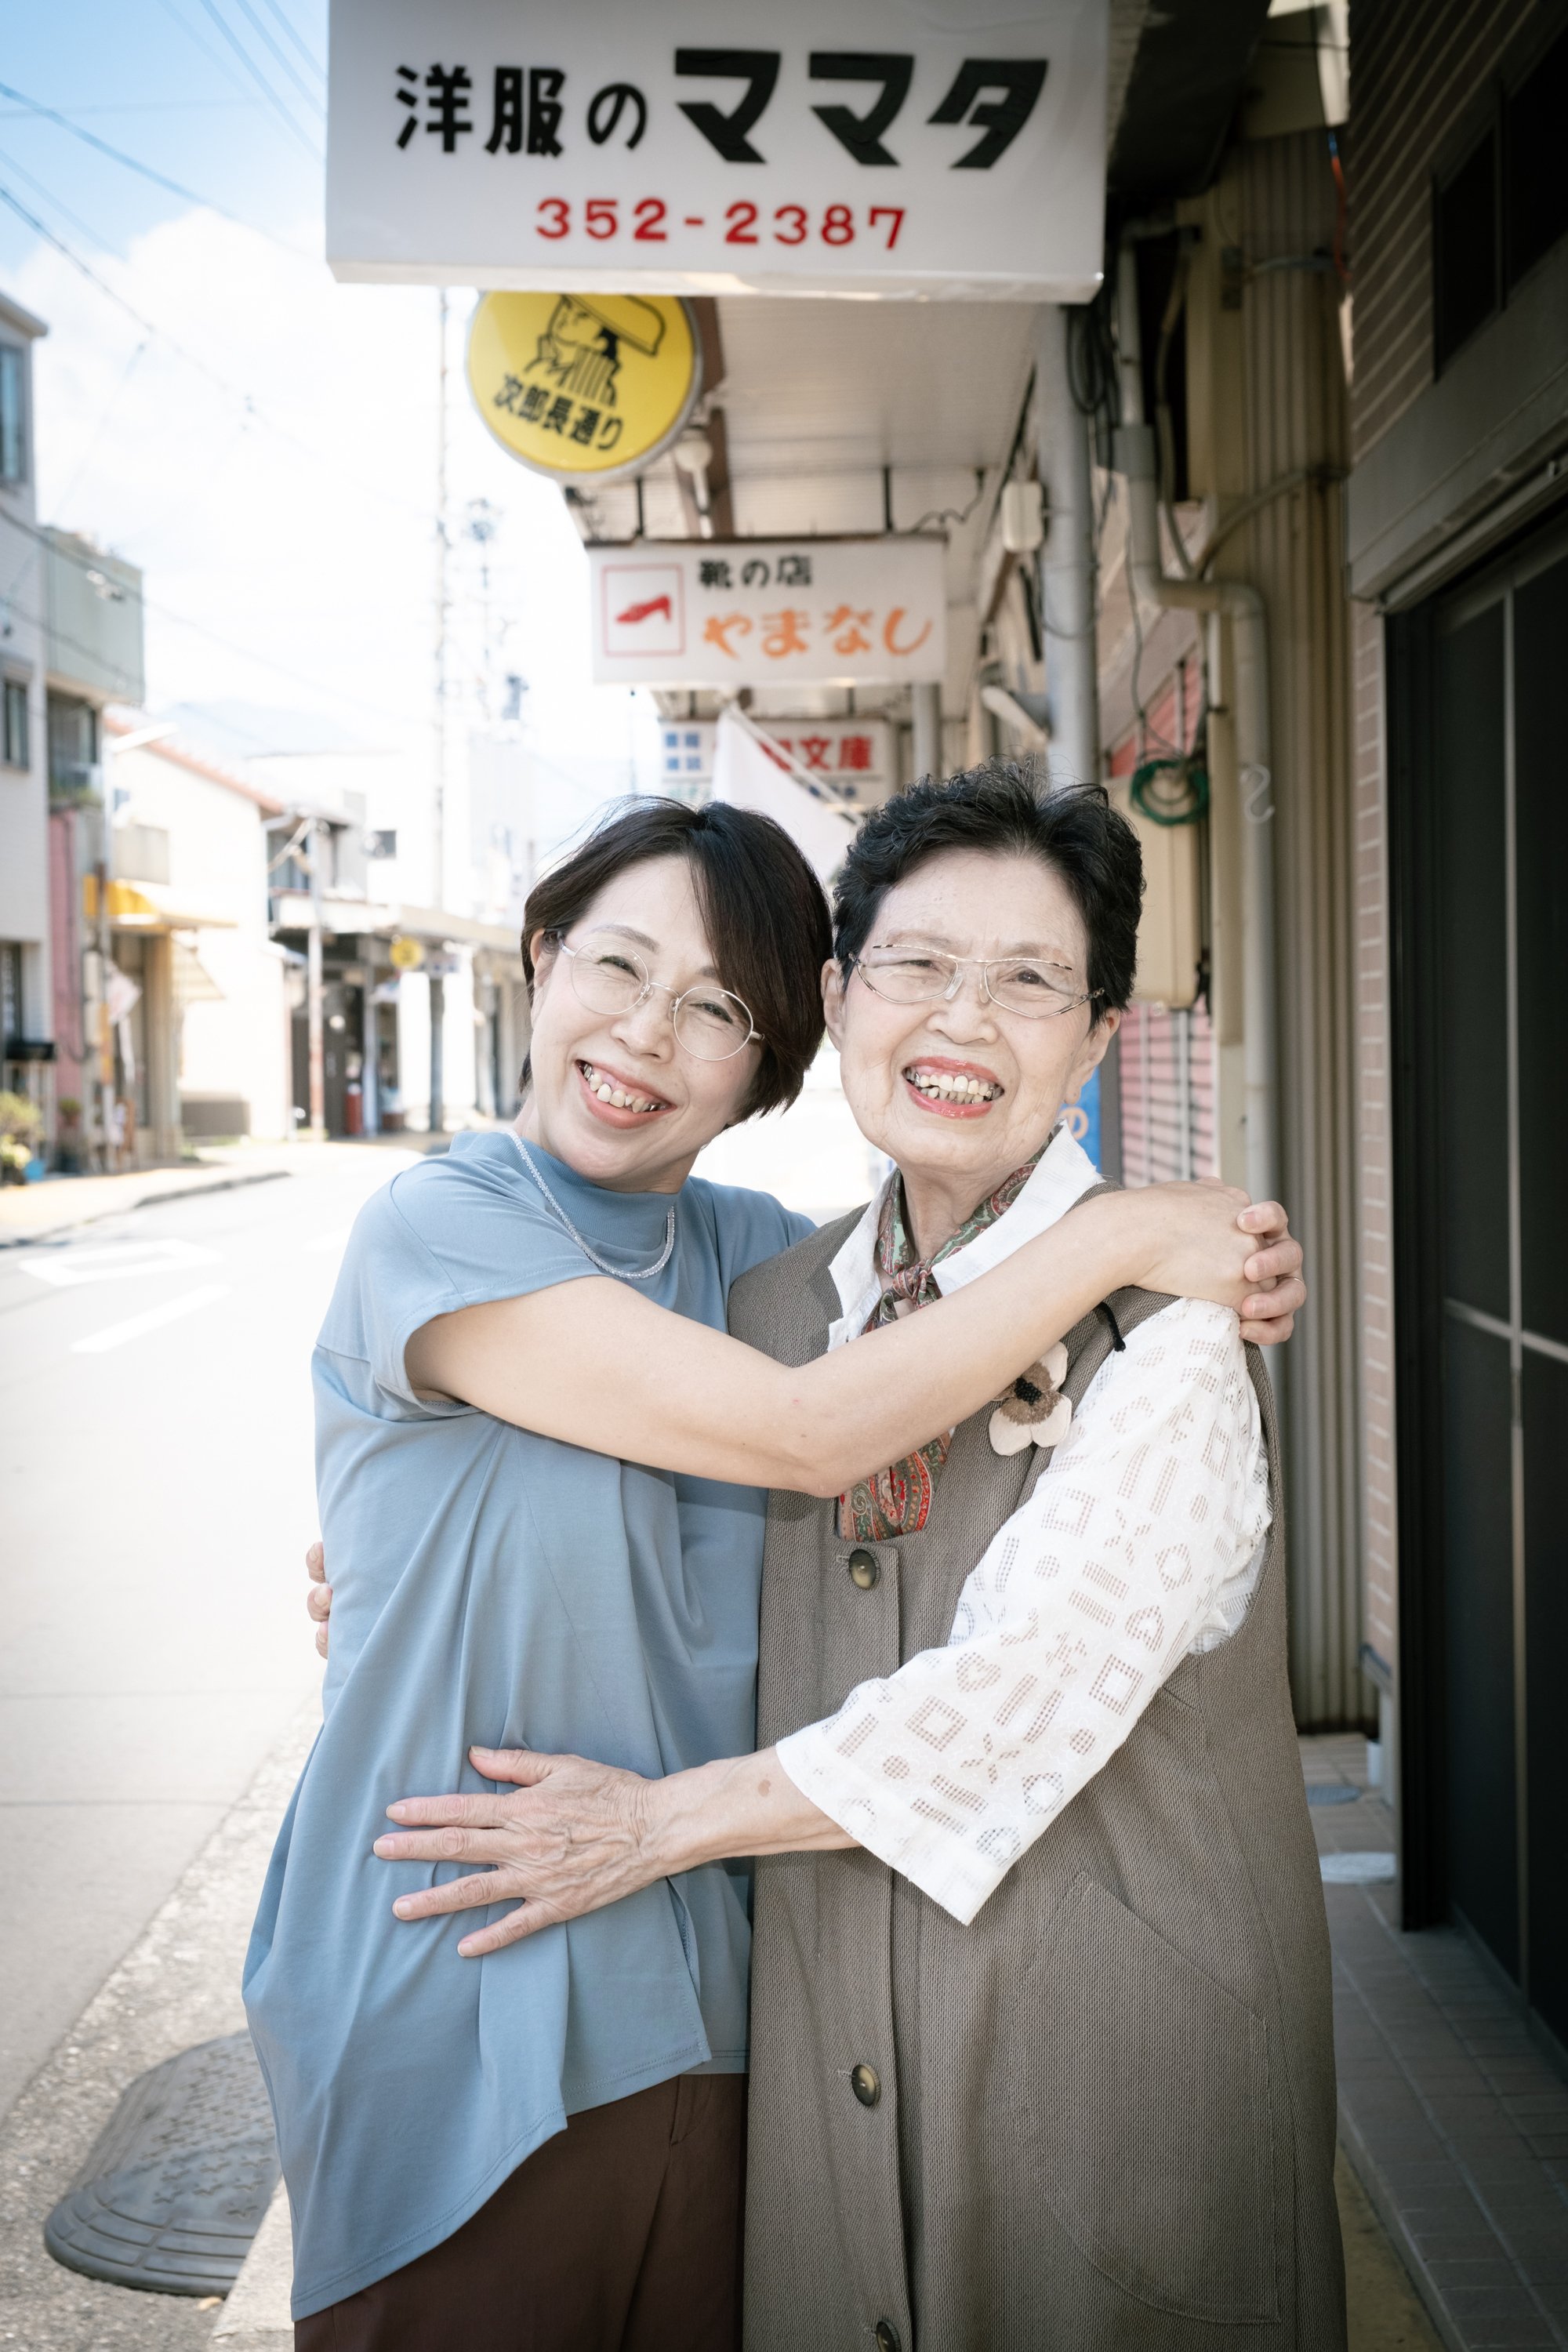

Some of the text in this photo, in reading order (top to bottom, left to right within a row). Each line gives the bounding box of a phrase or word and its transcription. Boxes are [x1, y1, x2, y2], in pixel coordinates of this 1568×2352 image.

[395, 48, 1049, 169] 洋服のママタ
[535, 197, 907, 250] 352-2387
[494, 373, 624, 451] 次郎長通り
[699, 554, 813, 589] 靴の店
[702, 604, 933, 660] やまなし
